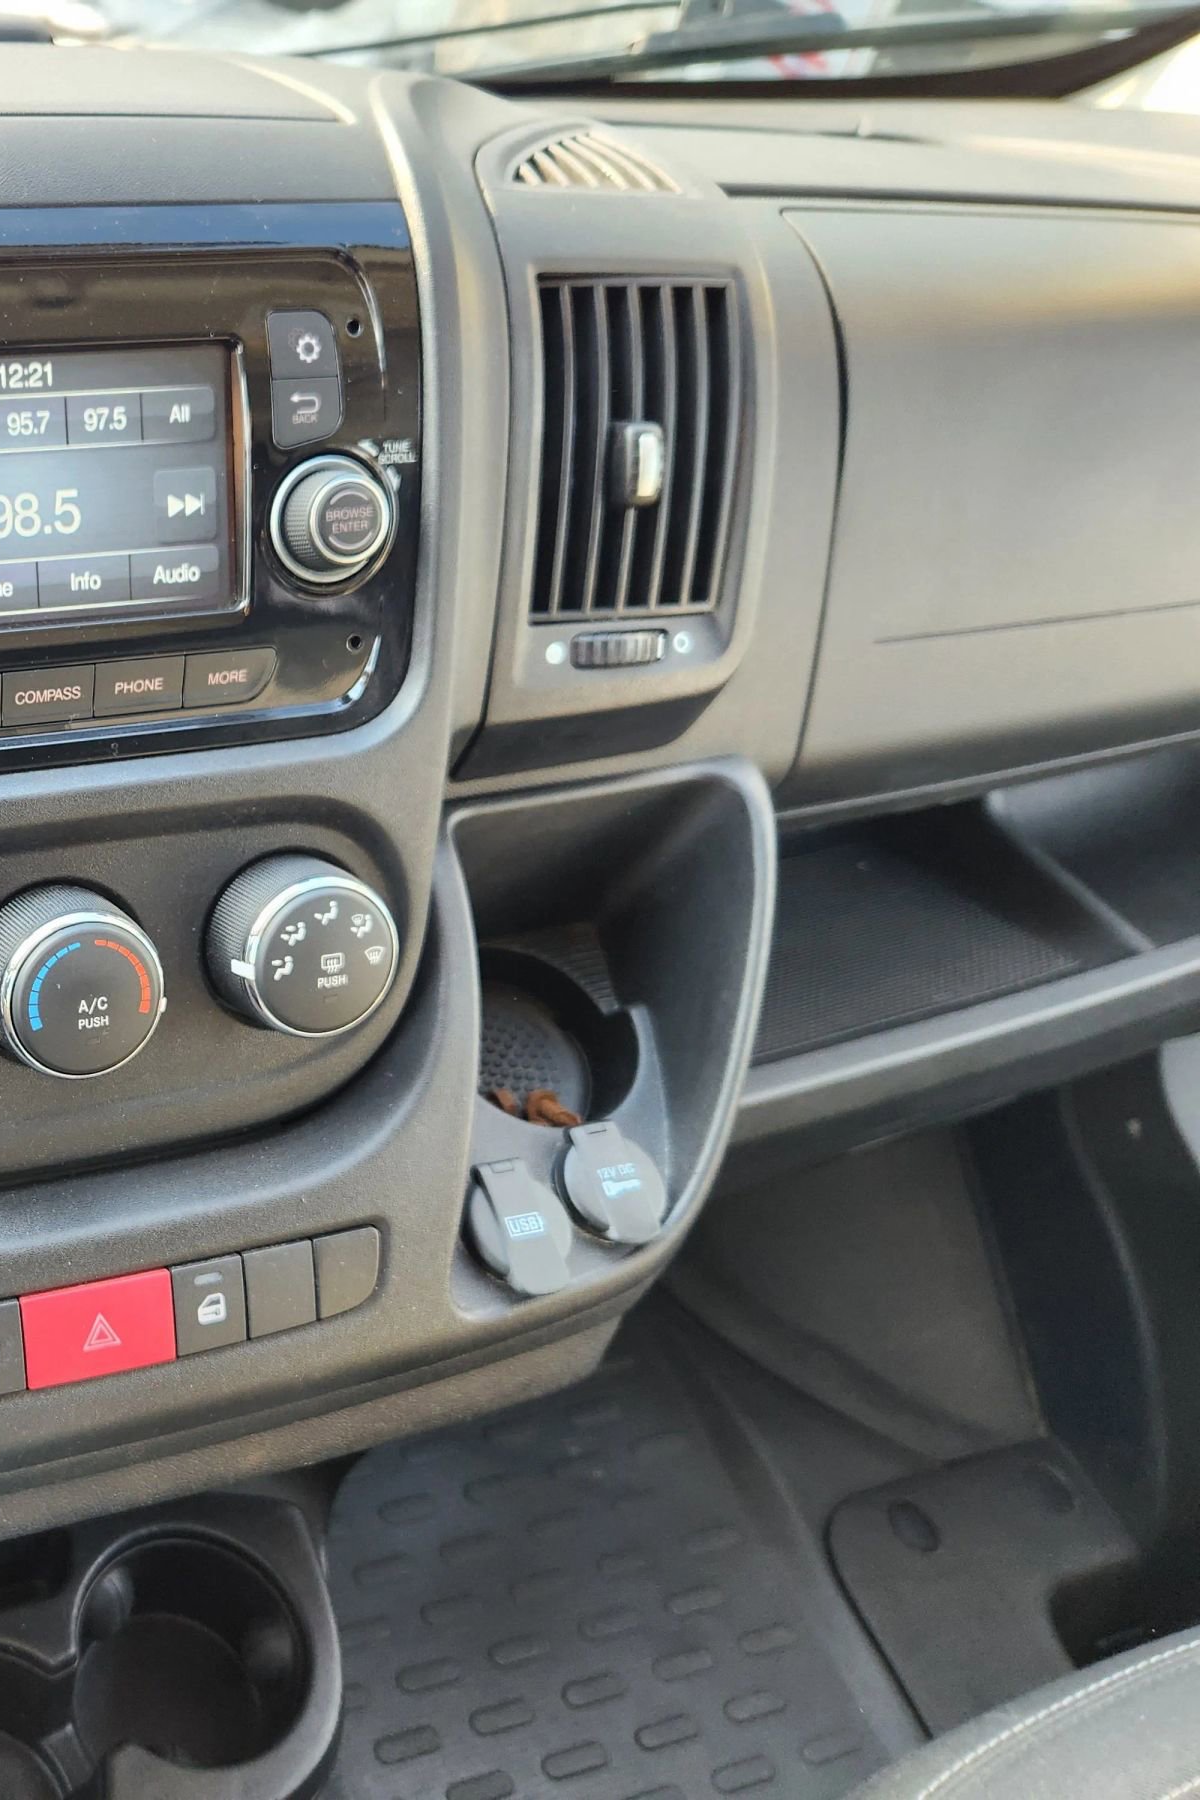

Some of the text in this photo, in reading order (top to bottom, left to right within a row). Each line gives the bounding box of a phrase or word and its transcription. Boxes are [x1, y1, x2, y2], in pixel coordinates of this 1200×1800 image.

[84, 407, 127, 431] 97.5
[169, 404, 191, 424] All
[292, 414, 318, 425] BACK
[7, 411, 50, 436] 95.7
[382, 440, 411, 453] TUNE
[378, 452, 417, 465] SCROLL
[325, 507, 375, 522] BROWSE
[332, 520, 369, 534] ENTER
[70, 571, 101, 592] Info
[153, 563, 201, 585] Audio
[114, 677, 165, 695] PHONE
[207, 669, 248, 686] MORE
[14, 686, 82, 706] COMPASS
[317, 974, 348, 988] PUSH
[77, 996, 109, 1014] A/C
[78, 1015, 110, 1030] PUSH
[509, 1217, 538, 1235] USB
